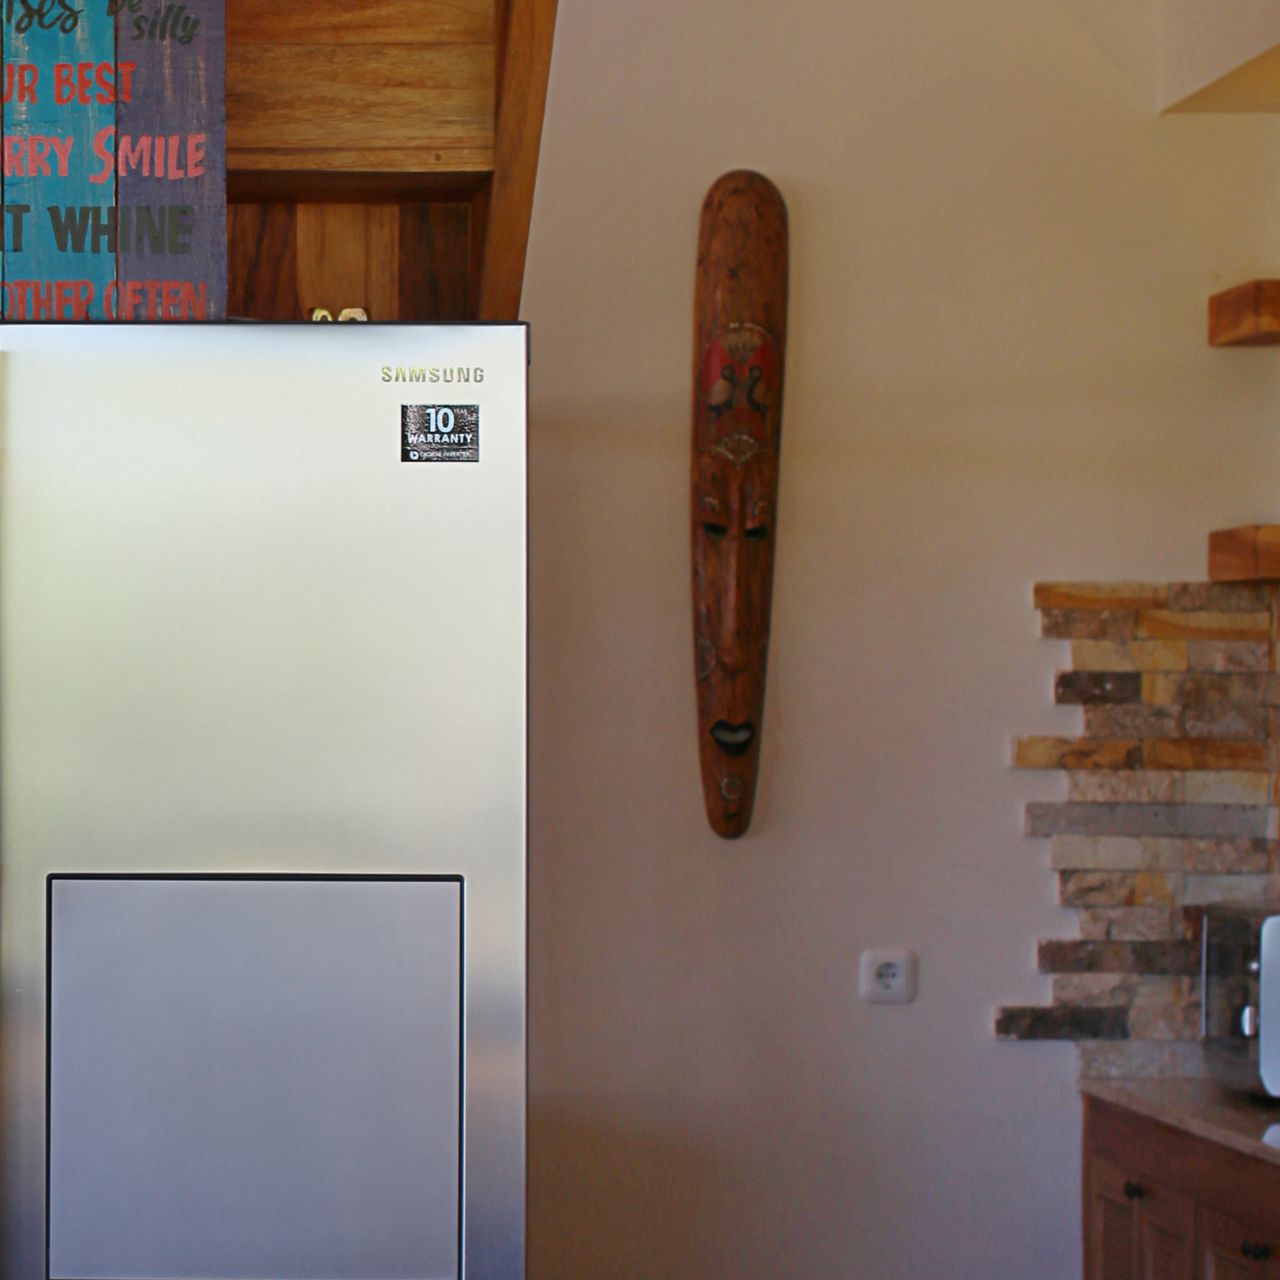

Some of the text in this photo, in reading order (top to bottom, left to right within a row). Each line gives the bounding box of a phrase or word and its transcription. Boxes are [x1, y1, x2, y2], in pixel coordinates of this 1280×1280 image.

[130, 3, 201, 46] silly
[53, 61, 137, 106] BEST
[89, 125, 207, 184] SMILE
[47, 204, 194, 254] WHINE
[103, 278, 208, 321] OFTEN
[380, 366, 485, 383] SAMSUNG
[406, 432, 473, 444] WARRANTY
[425, 406, 455, 434] 10
